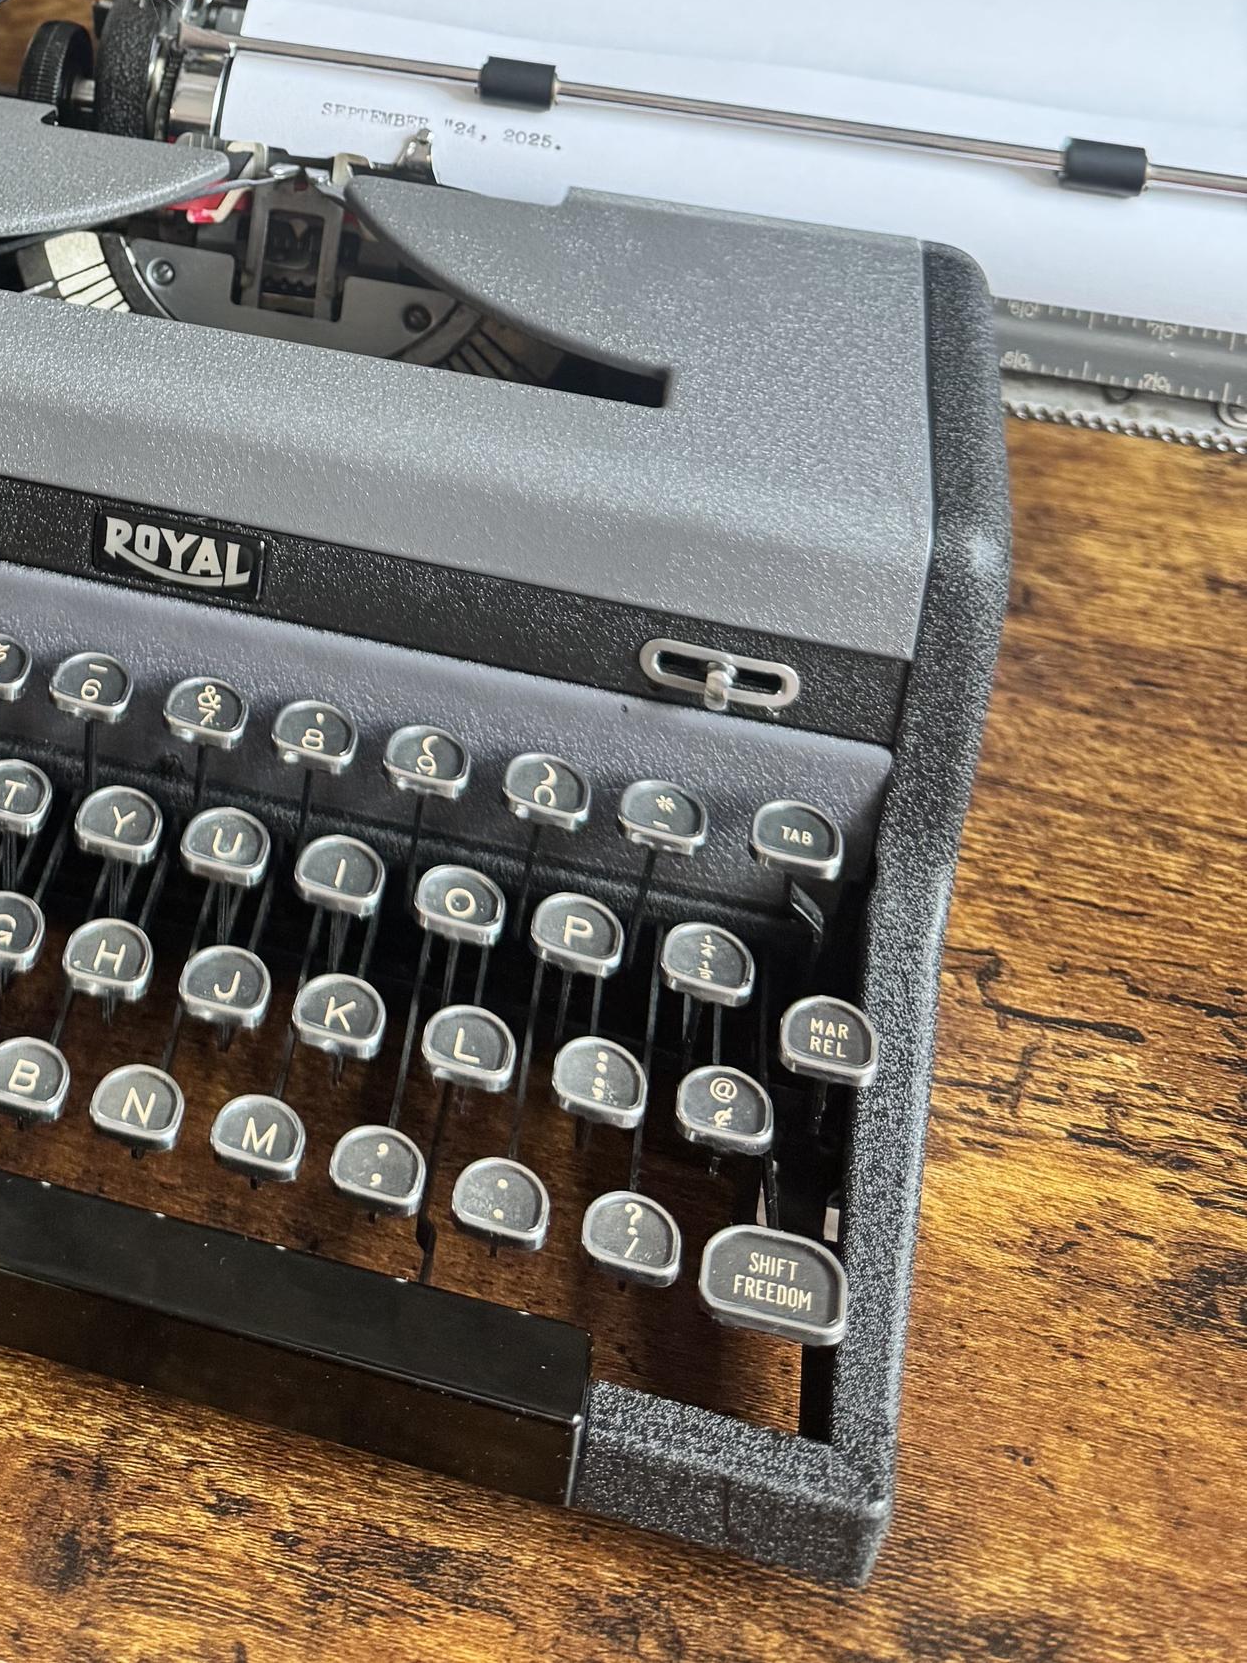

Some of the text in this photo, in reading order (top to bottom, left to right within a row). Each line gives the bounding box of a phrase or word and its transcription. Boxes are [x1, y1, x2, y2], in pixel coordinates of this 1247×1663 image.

[104, 516, 251, 587] ROYAL
[80, 679, 101, 701] 6
[197, 685, 222, 706] &
[301, 729, 324, 751] 8
[416, 754, 438, 776] 9
[4, 779, 27, 809] T
[112, 806, 137, 837] Y
[781, 825, 813, 846] TAB
[212, 828, 243, 858] U
[334, 858, 346, 889] I
[444, 887, 476, 918] O
[564, 915, 594, 947] P
[93, 939, 127, 975] H
[213, 970, 241, 1002] J
[324, 996, 357, 1033] K
[810, 1017, 849, 1040] MAR
[453, 1027, 480, 1064] L
[809, 1035, 847, 1058] REL
[8, 1058, 41, 1094] B
[709, 1077, 738, 1104] @
[120, 1086, 156, 1128] N
[241, 1116, 278, 1157] M
[748, 1251, 799, 1281] SHIFT
[733, 1274, 813, 1311] FREEDOM
